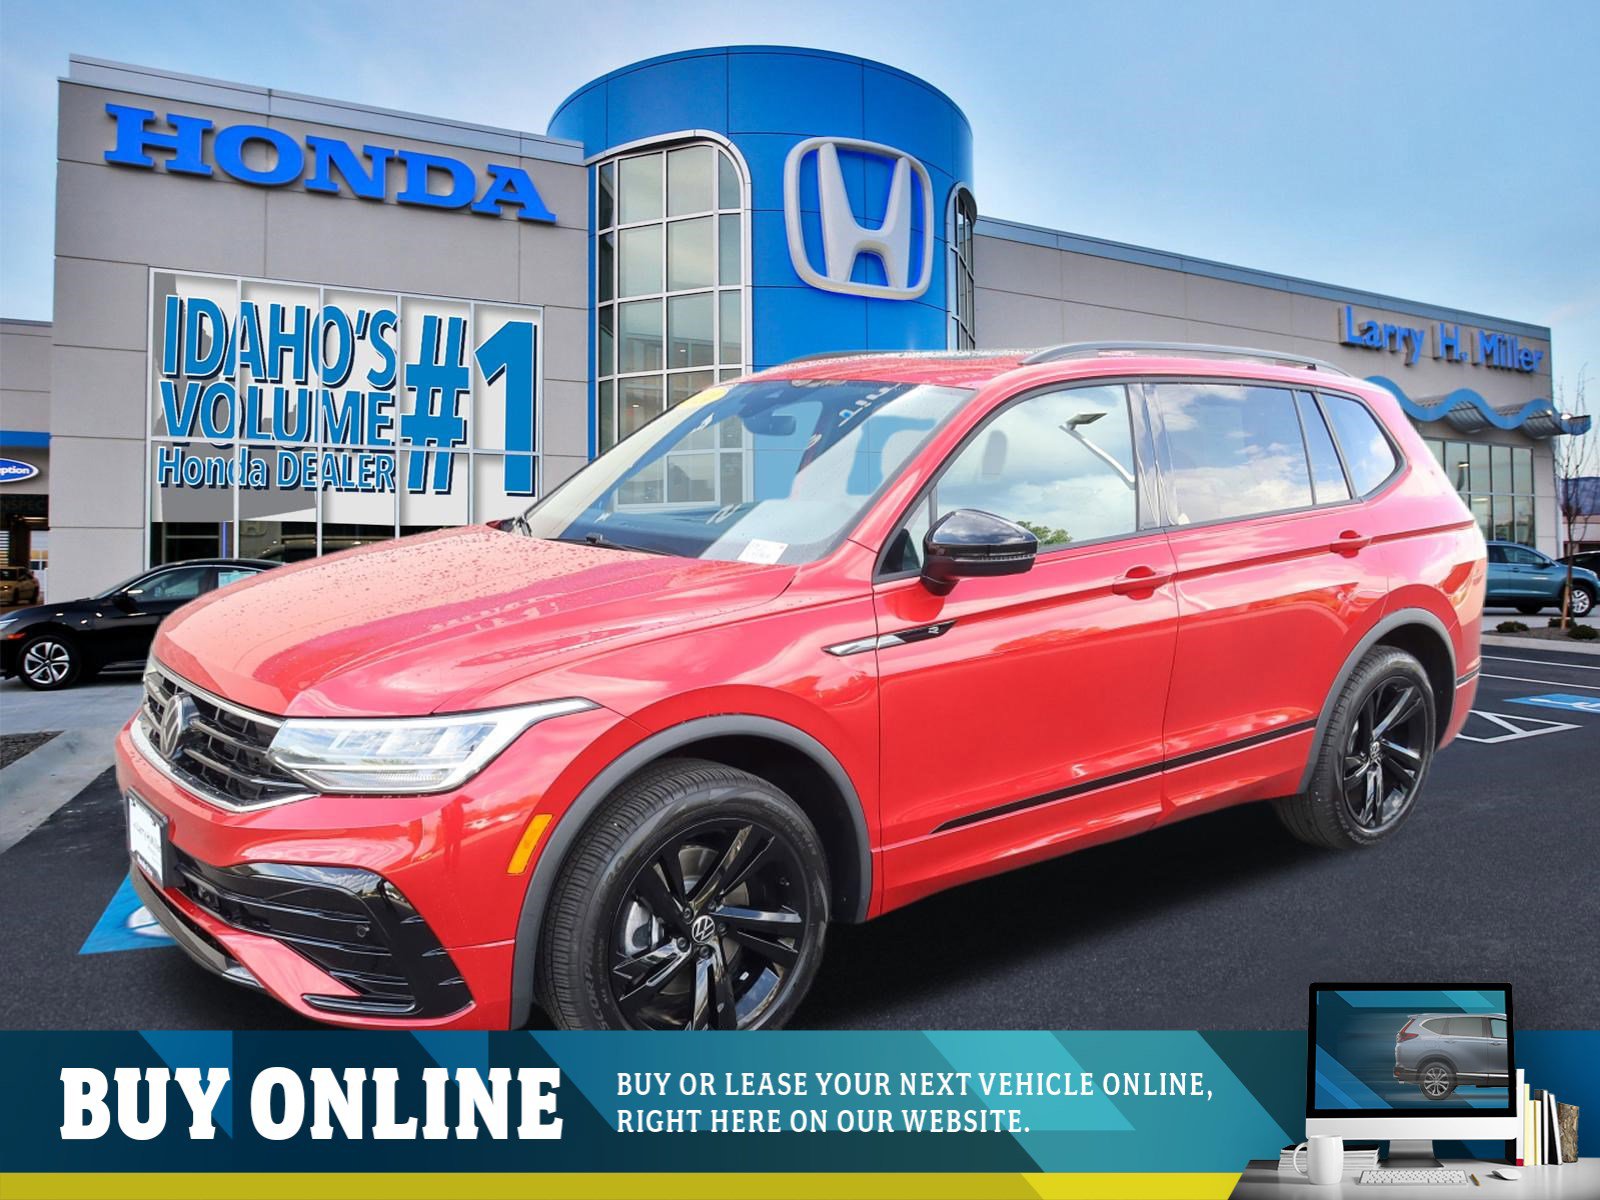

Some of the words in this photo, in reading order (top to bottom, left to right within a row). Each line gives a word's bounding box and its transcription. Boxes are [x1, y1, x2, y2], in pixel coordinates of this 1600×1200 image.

[104, 103, 557, 223] HONDA
[162, 295, 398, 389] IDAHO'S
[1342, 305, 1425, 366] Larry
[1437, 323, 1468, 362] H.
[1476, 329, 1544, 373] Miller
[159, 380, 397, 449] VOLUME
[400, 315, 537, 496] #1
[0, 465, 31, 476] ption
[157, 446, 271, 490] Honda
[276, 450, 396, 491] DEALER
